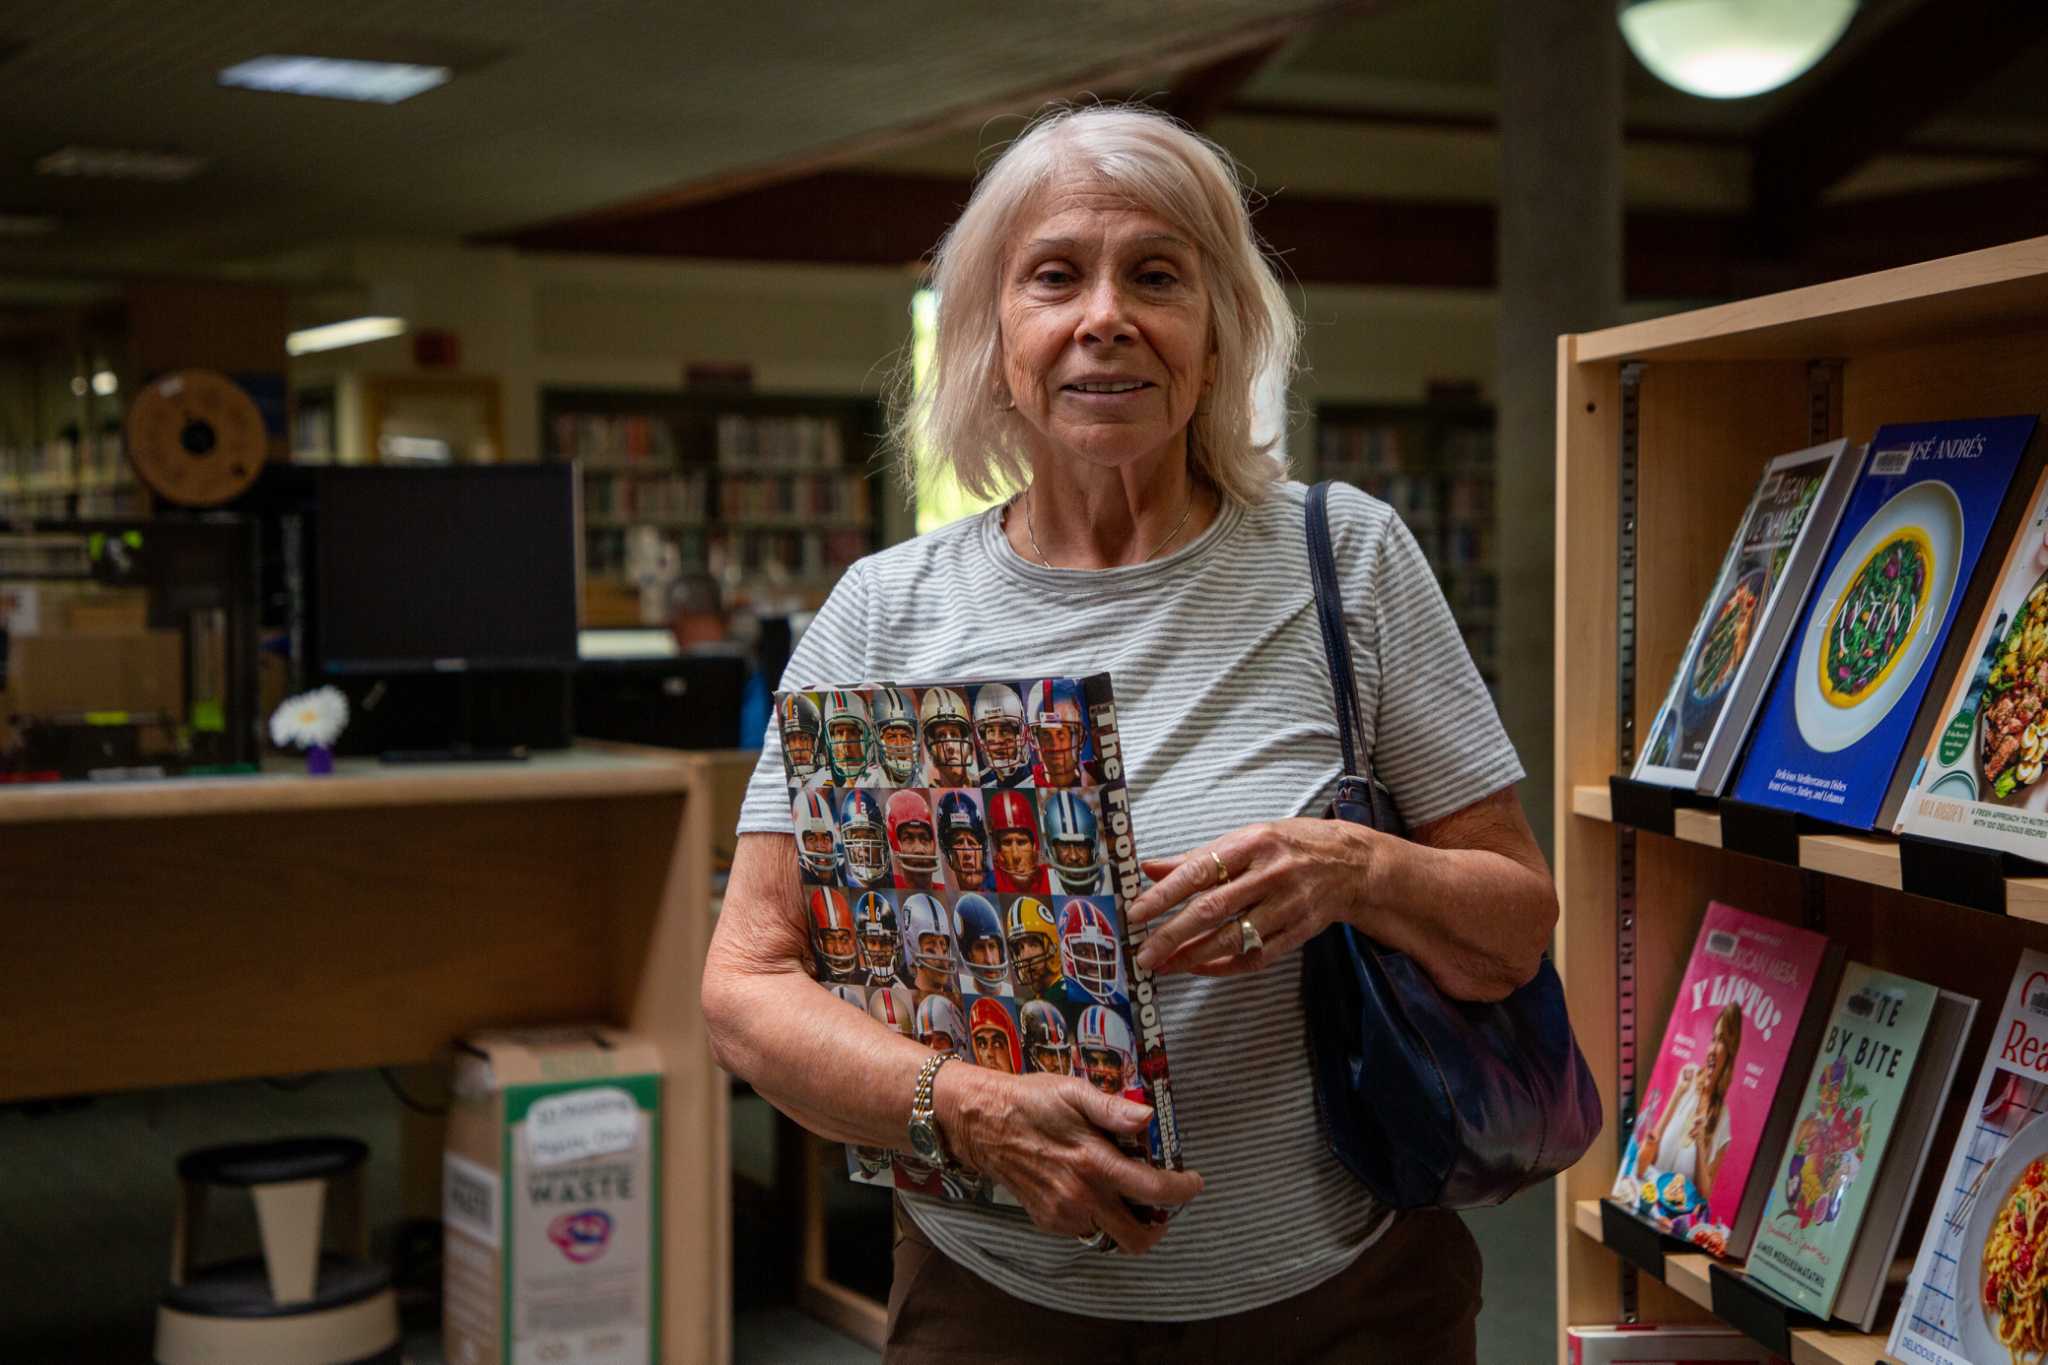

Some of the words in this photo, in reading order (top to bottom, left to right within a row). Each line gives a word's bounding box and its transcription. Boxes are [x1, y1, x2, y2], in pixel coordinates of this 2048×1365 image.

[1934, 433, 1986, 460] ANDRÉS
[1096, 704, 1120, 781] The
[1691, 978, 1709, 1014] Y
[1709, 975, 1783, 1042] LISTO!
[1825, 1026, 1854, 1057] BY
[1853, 1036, 1903, 1078] BITE
[528, 1175, 634, 1206] WASTE
[1902, 1336, 1937, 1362] DELICIOUS
